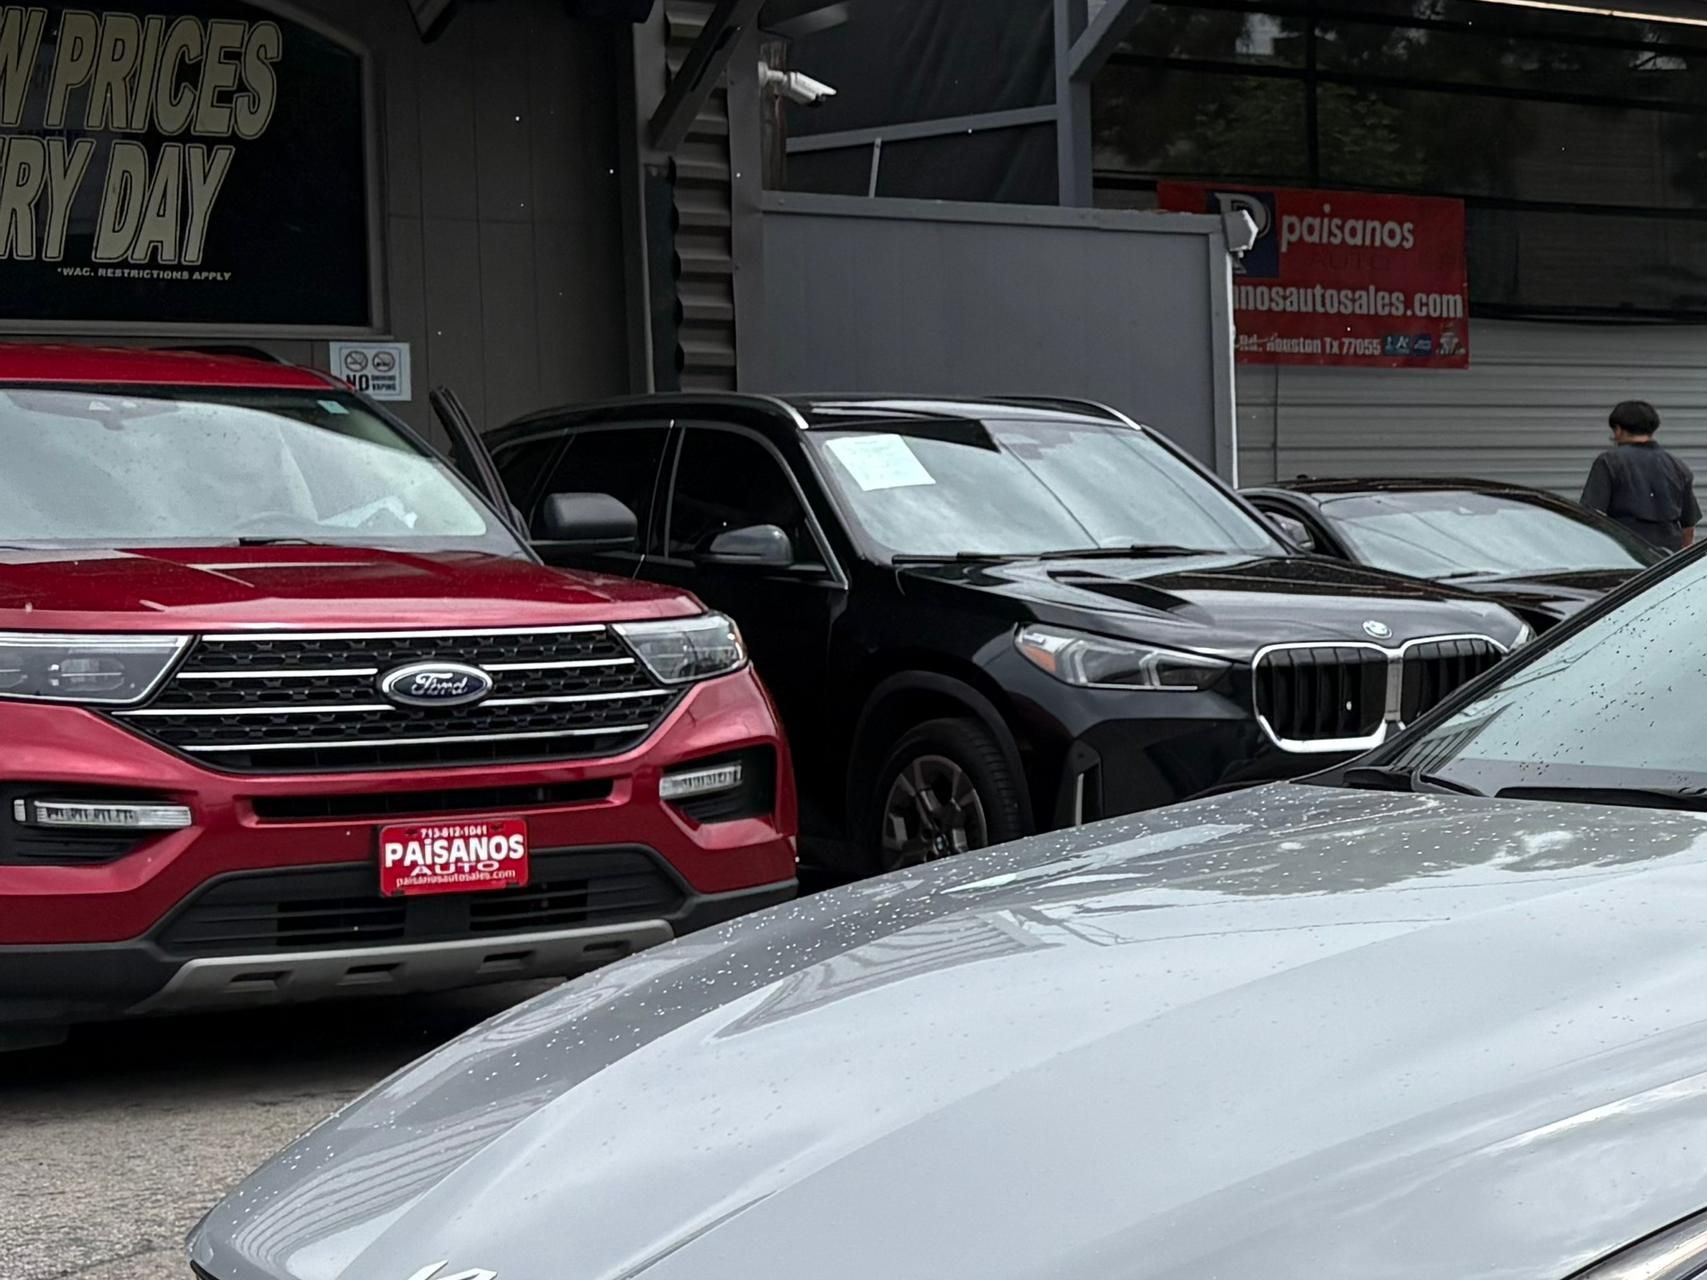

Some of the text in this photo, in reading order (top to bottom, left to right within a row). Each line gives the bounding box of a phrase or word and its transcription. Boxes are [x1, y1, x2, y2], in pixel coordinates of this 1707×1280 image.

[44, 9, 282, 140] PRICES
[92, 139, 236, 265] DAY
[1280, 203, 1414, 253] paisanos
[98, 267, 189, 280] RESTRICTIONS
[192, 271, 232, 281] APPLY
[1233, 283, 1464, 319] nosautosales.com
[1341, 337, 1382, 356] 77055
[411, 672, 468, 696] Ford
[410, 860, 500, 877] AUTO
